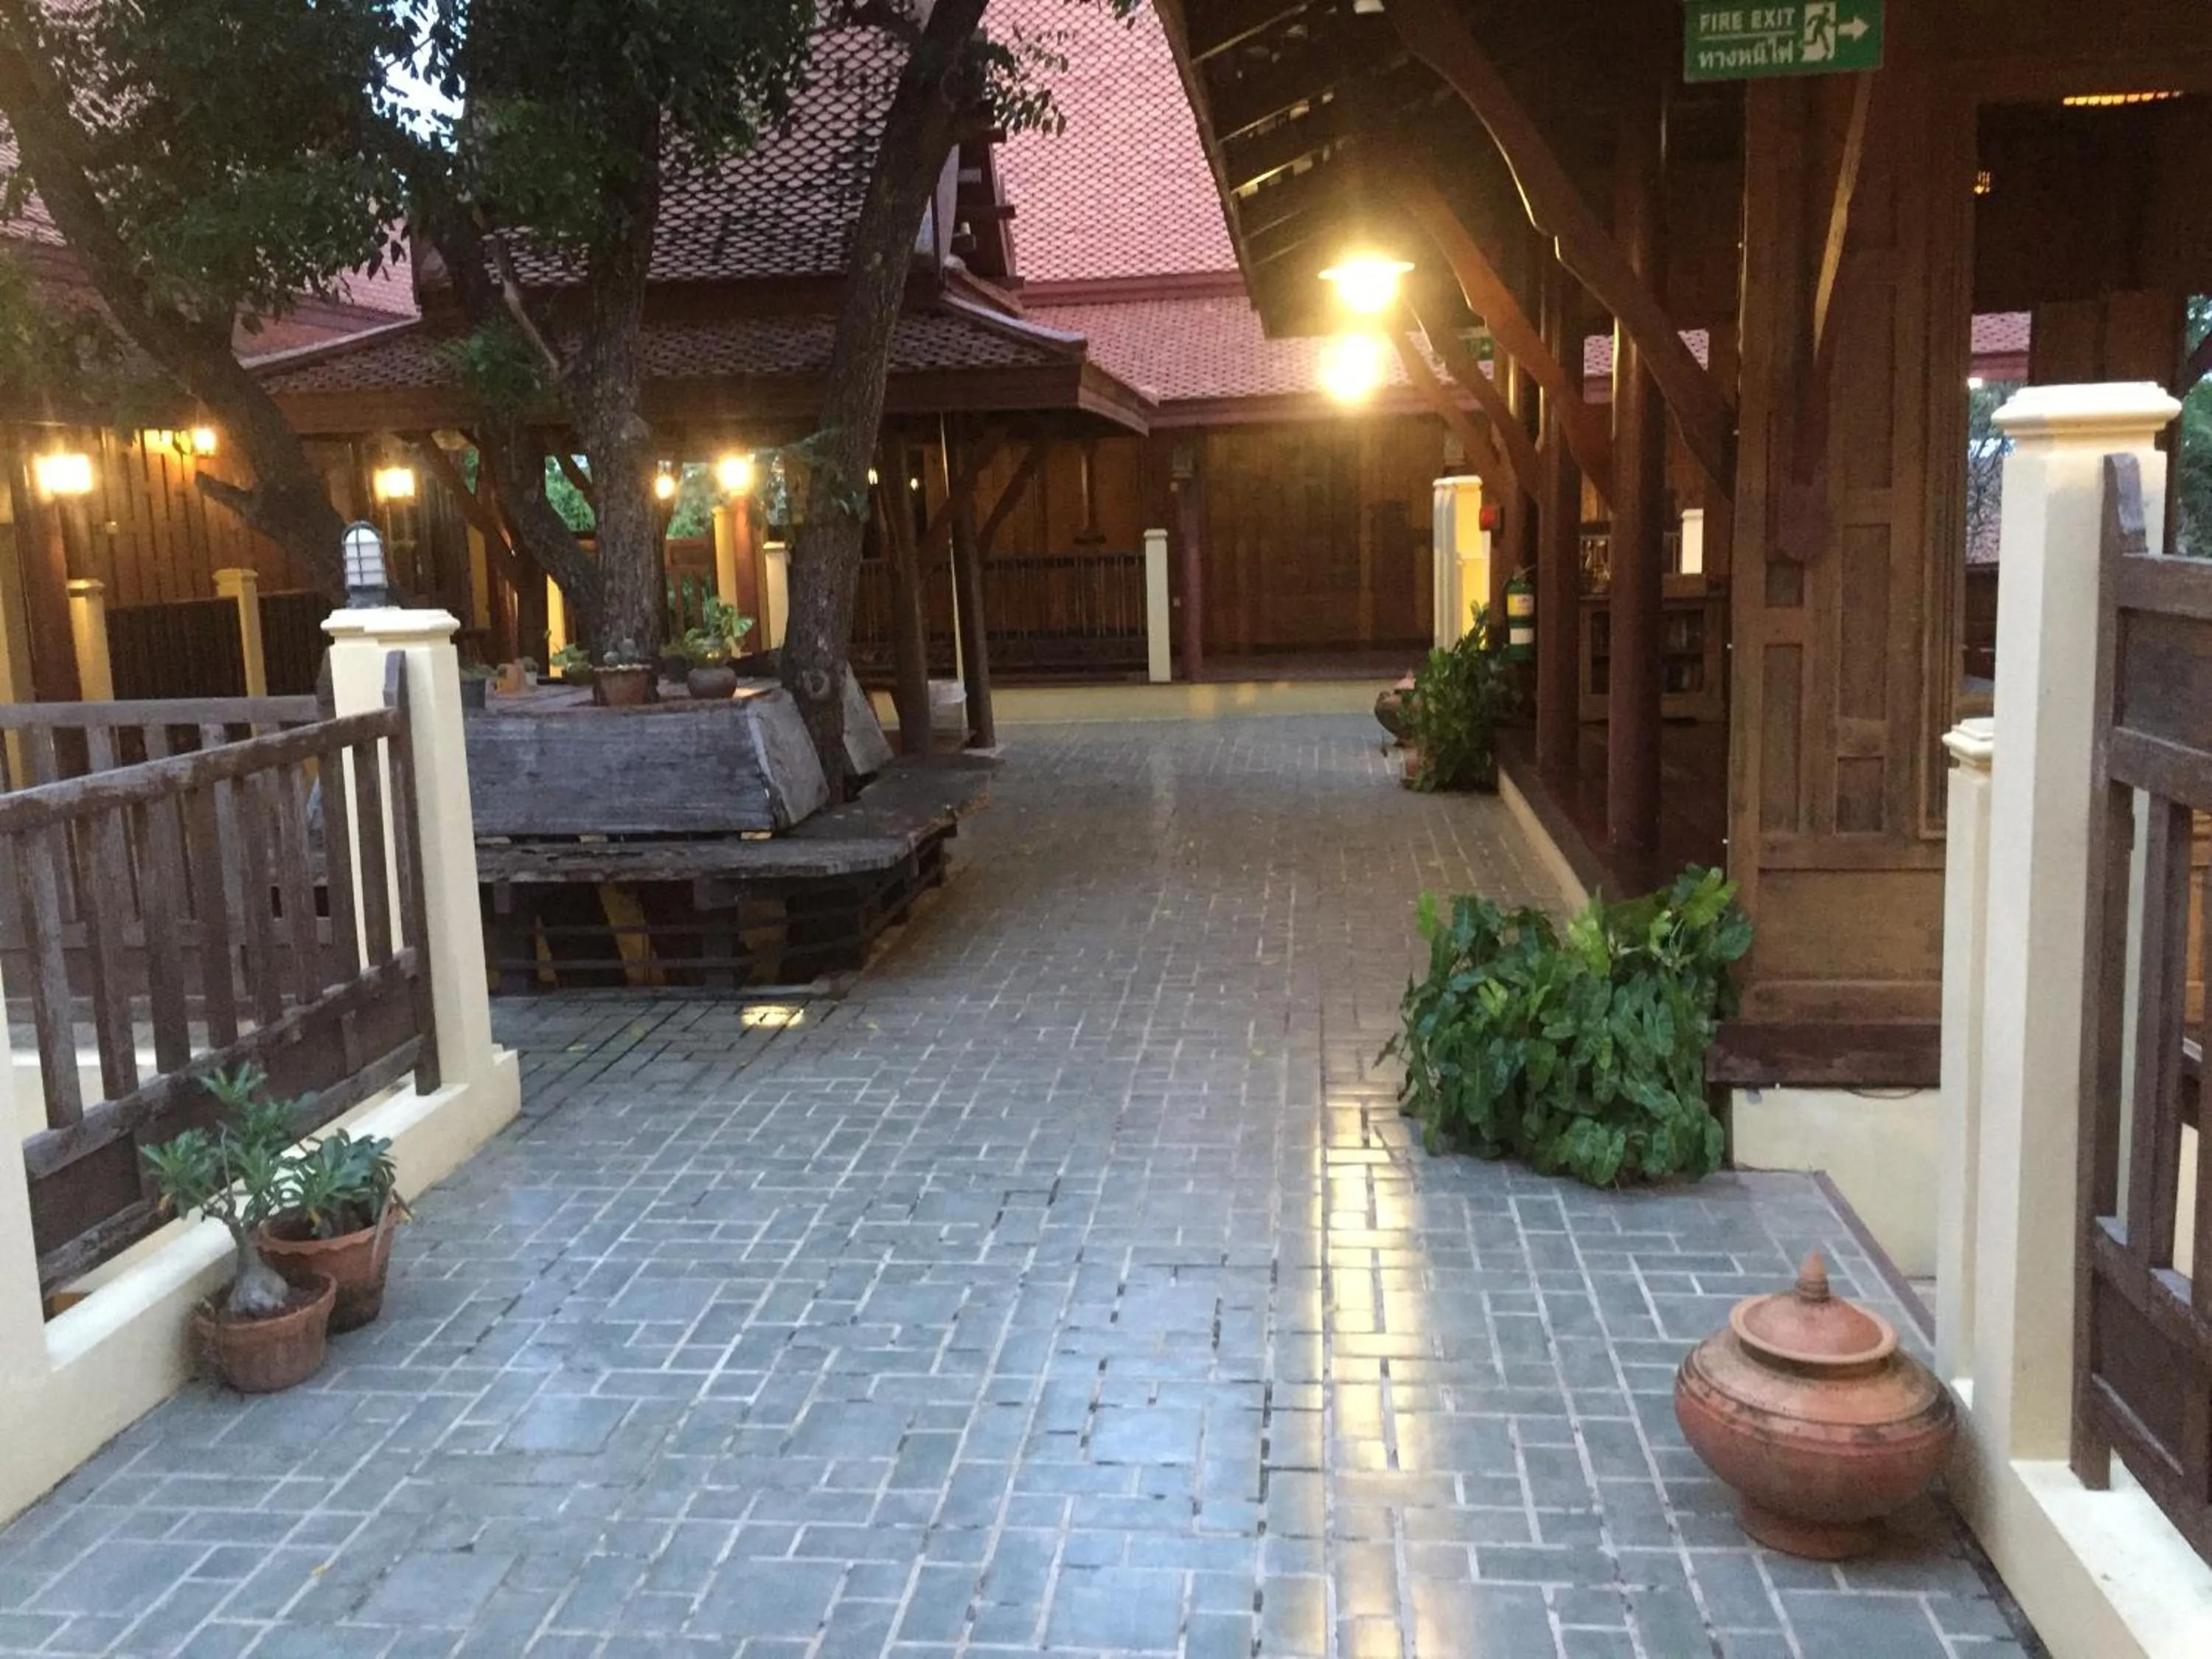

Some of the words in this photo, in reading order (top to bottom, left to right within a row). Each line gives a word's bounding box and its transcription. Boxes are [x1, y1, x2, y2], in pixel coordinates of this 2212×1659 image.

[1700, 10, 1744, 32] FIRE
[1750, 7, 1795, 29] EXIT
[1698, 35, 1794, 69] ทางหนีไฟ
